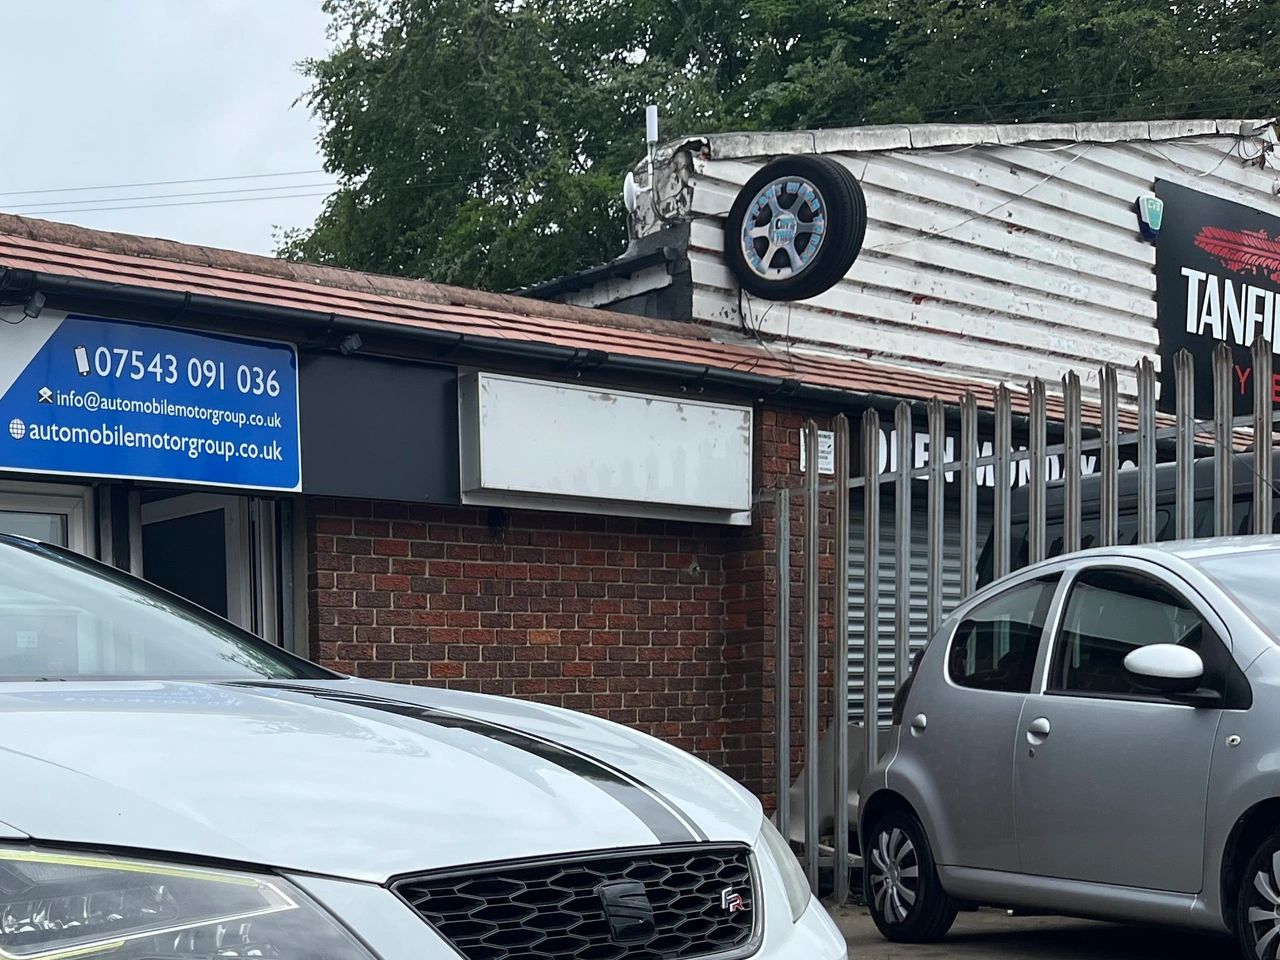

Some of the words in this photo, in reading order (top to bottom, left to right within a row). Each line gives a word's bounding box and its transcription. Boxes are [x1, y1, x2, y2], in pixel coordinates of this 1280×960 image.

[94, 346, 178, 384] 07543
[187, 358, 225, 390] 091
[237, 365, 280, 397] 036
[56, 389, 282, 429] info@automobilemotorgroup.co.uk
[28, 421, 283, 461] automobilemotorgroup.co.uk
